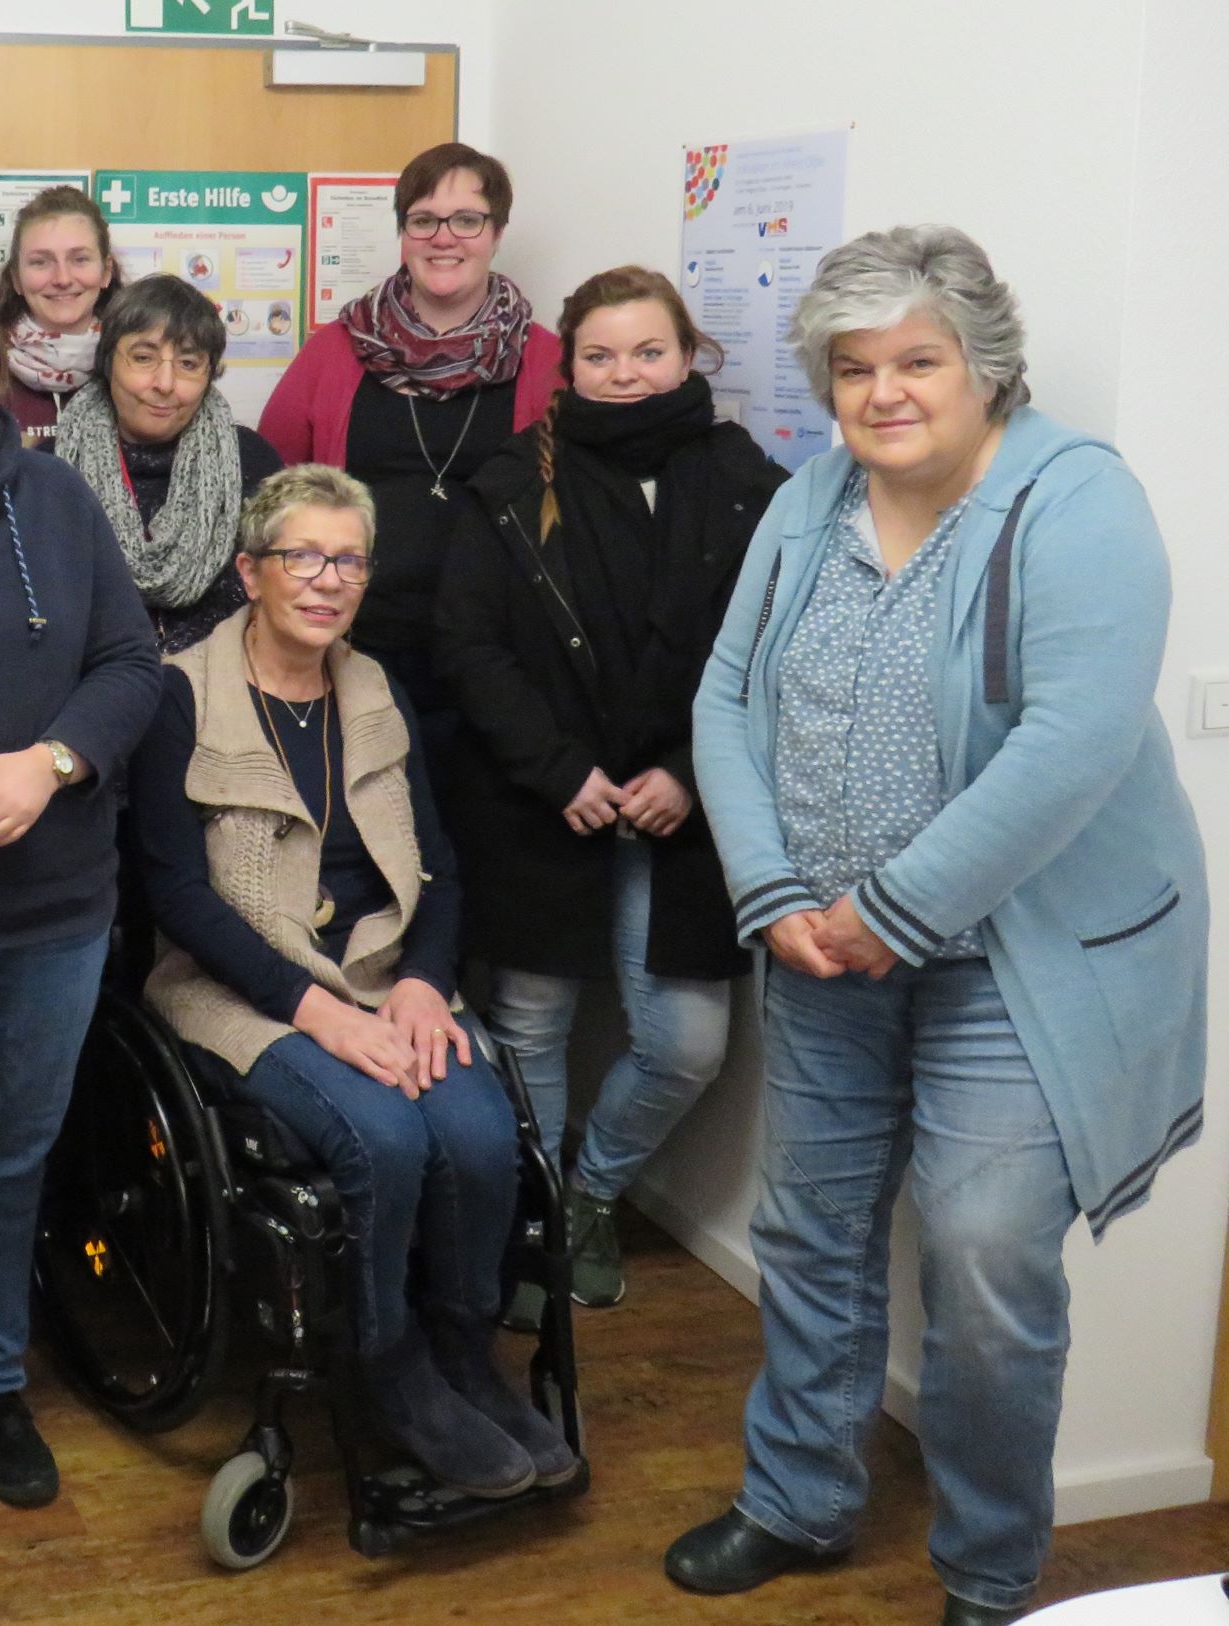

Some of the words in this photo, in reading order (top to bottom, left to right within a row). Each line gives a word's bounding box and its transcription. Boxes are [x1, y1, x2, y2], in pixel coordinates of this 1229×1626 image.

[148, 187, 199, 207] Erste
[204, 187, 251, 207] Hilfe
[154, 231, 194, 240] Auffinden
[195, 231, 216, 240] einer
[218, 231, 246, 240] Person
[758, 217, 787, 237] VHS
